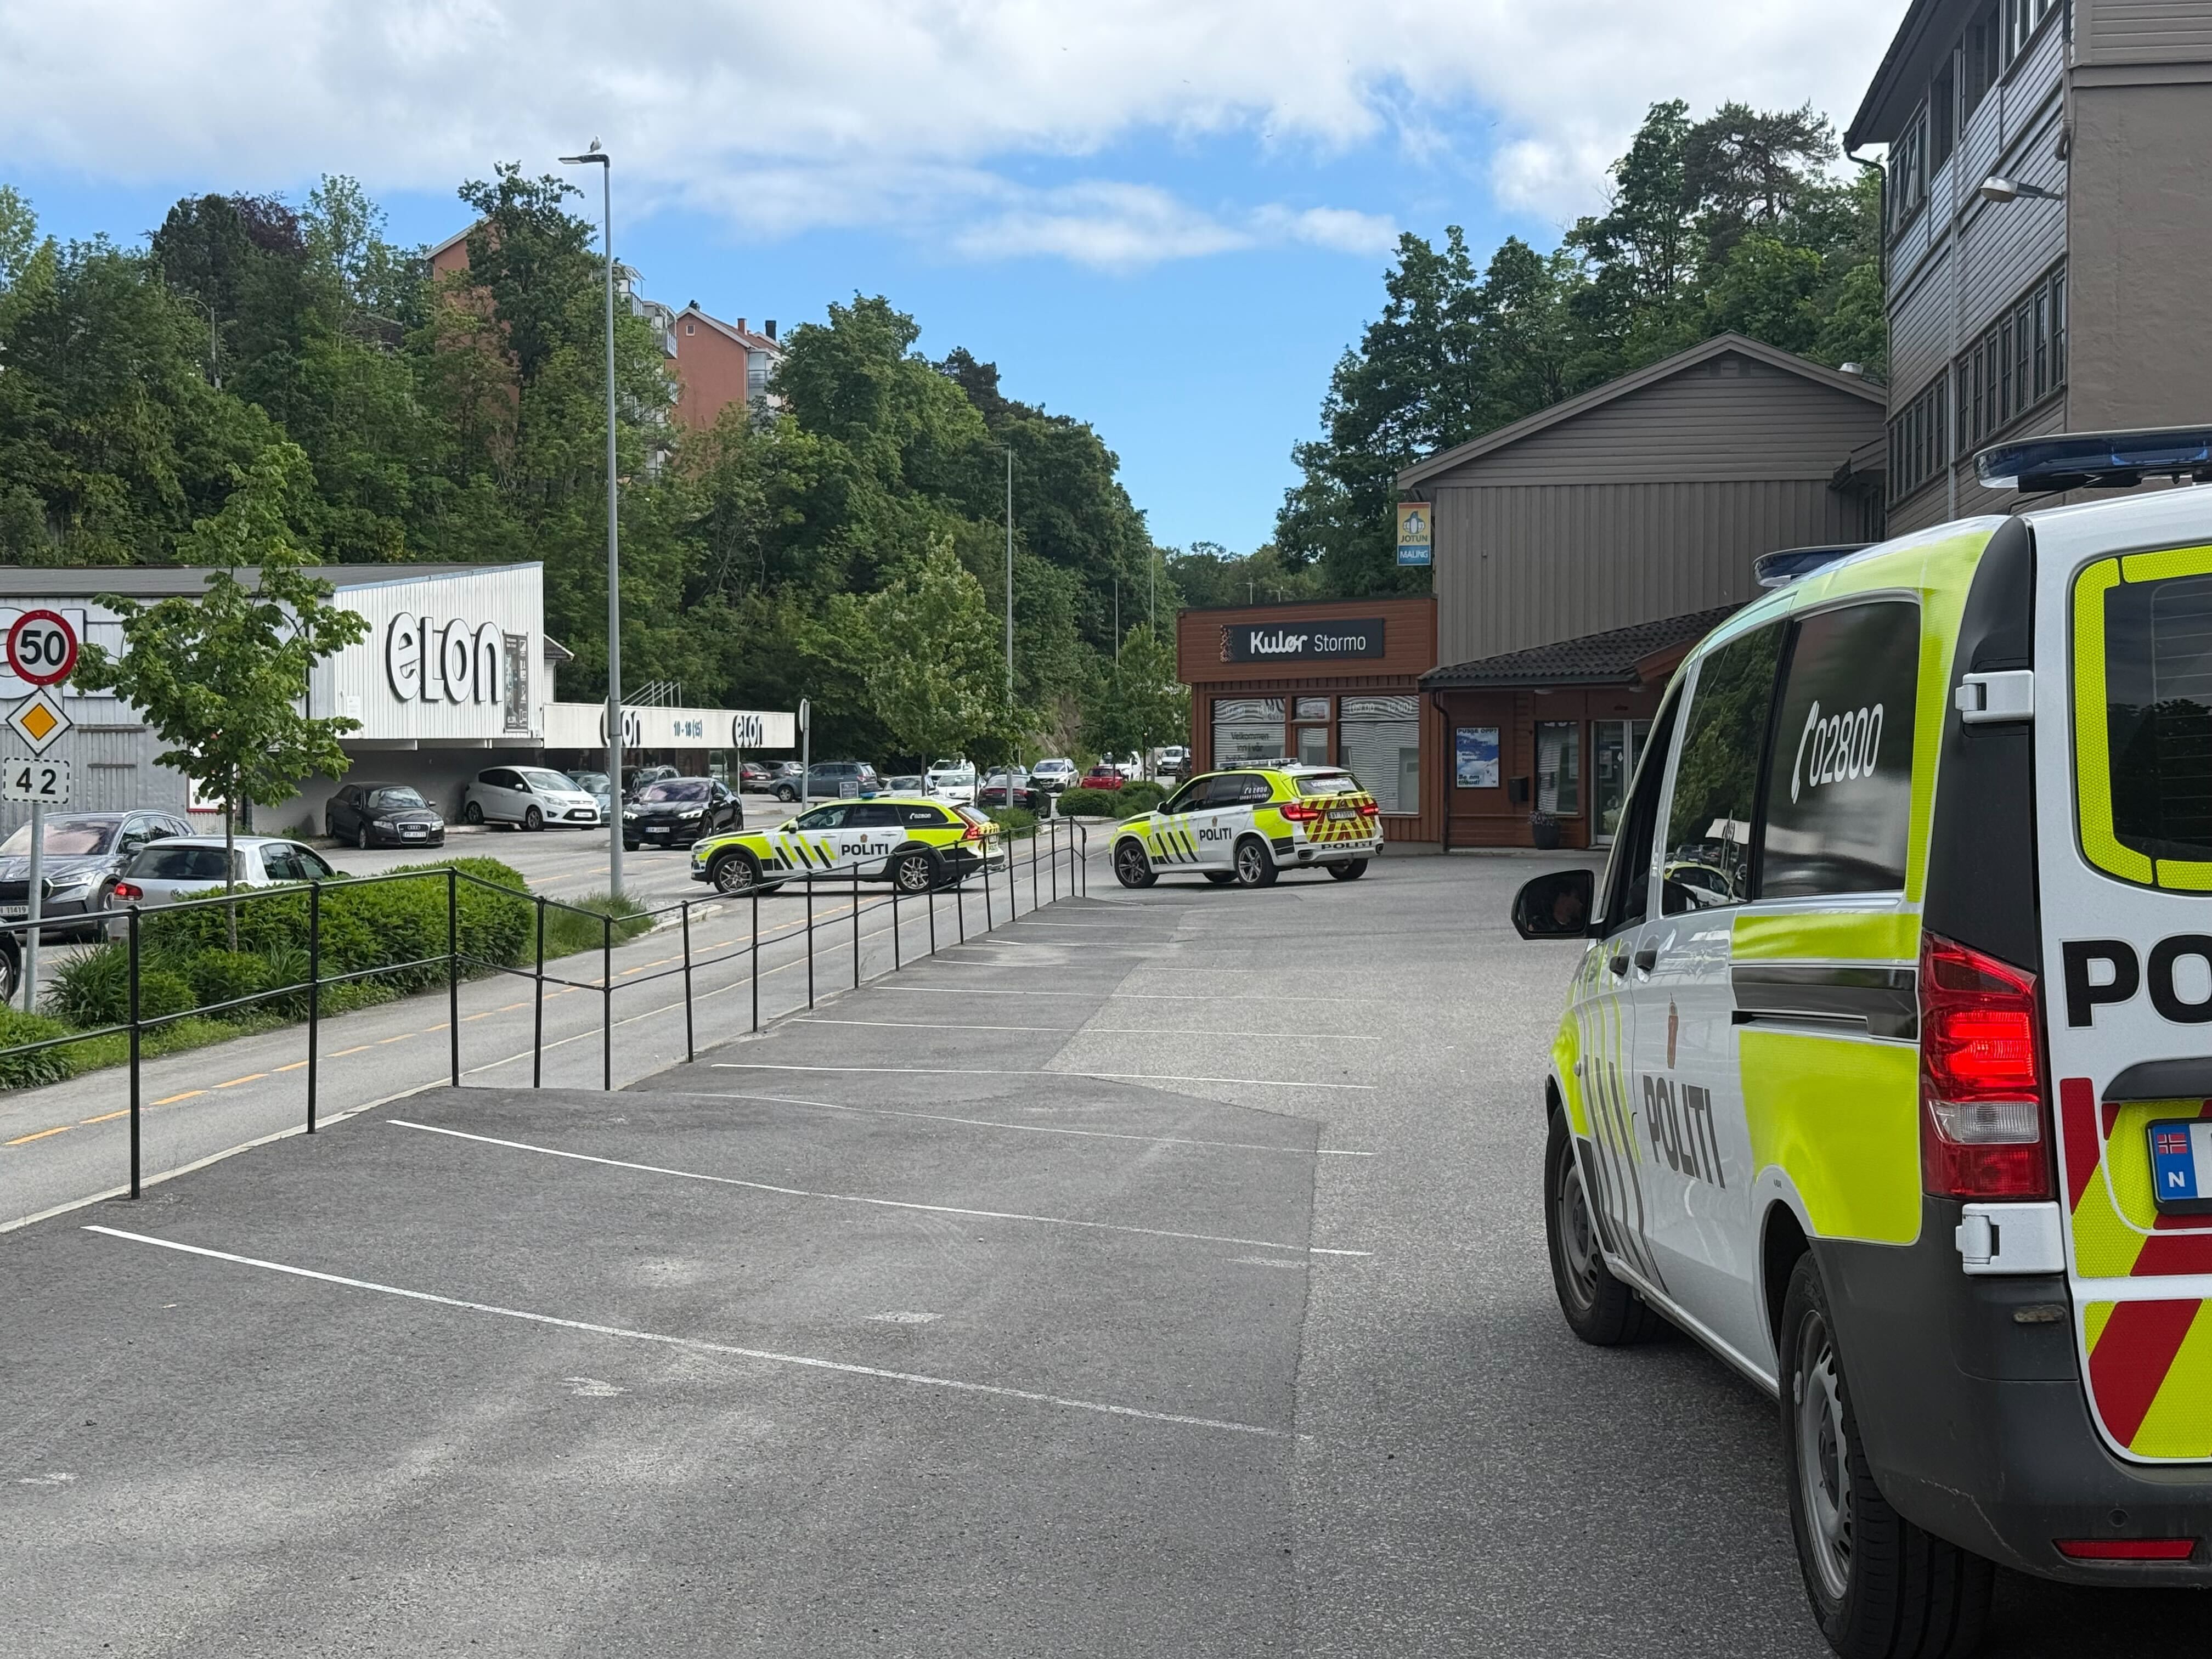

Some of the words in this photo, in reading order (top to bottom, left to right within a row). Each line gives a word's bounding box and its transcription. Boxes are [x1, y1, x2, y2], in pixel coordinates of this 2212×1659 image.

[1400, 550, 1428, 558] MALING
[19, 630, 66, 666] 50
[1314, 634, 1367, 652] Stormo
[674, 721, 680, 737] 10
[685, 721, 691, 737] 18
[1809, 703, 1883, 787] 02800
[16, 767, 57, 795] 42
[1199, 828, 1232, 841] POLITI
[842, 844, 889, 856] POLITI
[1321, 842, 1372, 850] POLITI
[1643, 1075, 1726, 1189] POLITI
[2168, 1171, 2186, 1188] N
